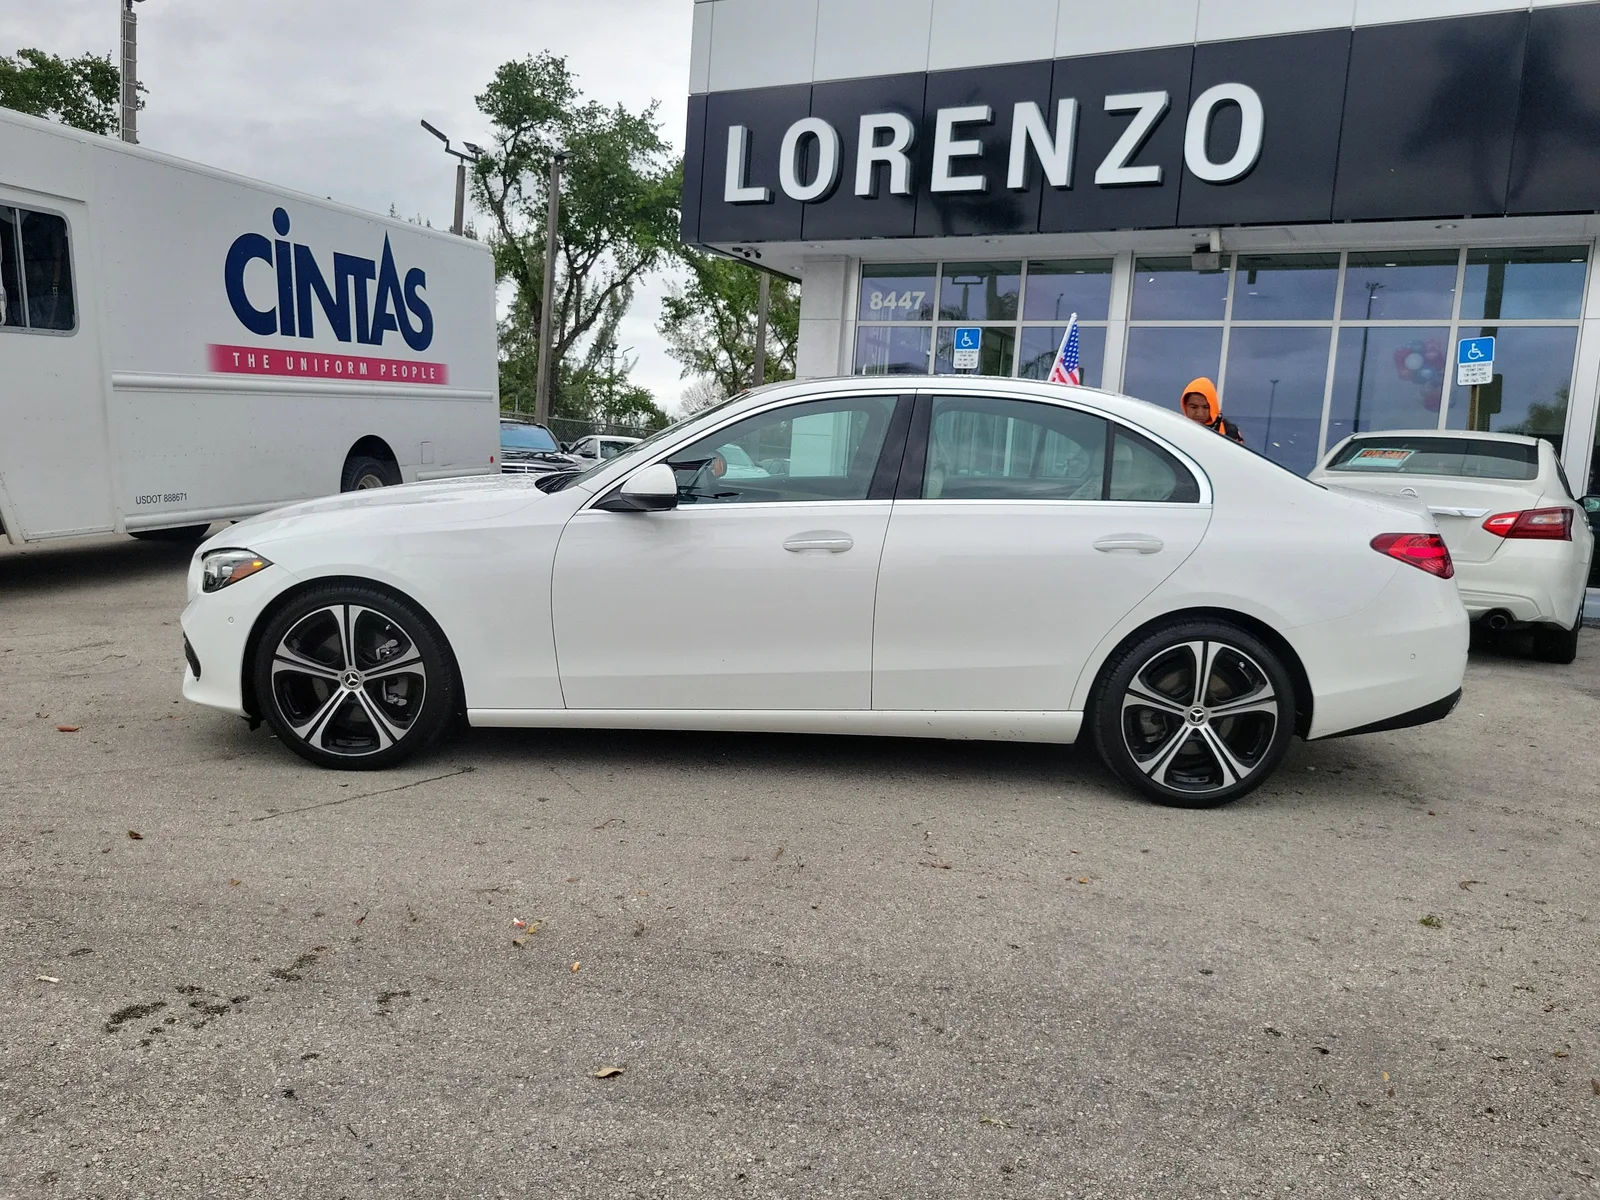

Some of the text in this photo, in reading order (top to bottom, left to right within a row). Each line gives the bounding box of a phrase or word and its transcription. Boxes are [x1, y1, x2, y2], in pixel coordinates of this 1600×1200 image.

[723, 82, 1265, 204] LORENZO
[869, 290, 927, 311] 8447
[232, 352, 436, 380] THE UNIFORM PEOPLE
[135, 492, 188, 505] USDOT 888671
